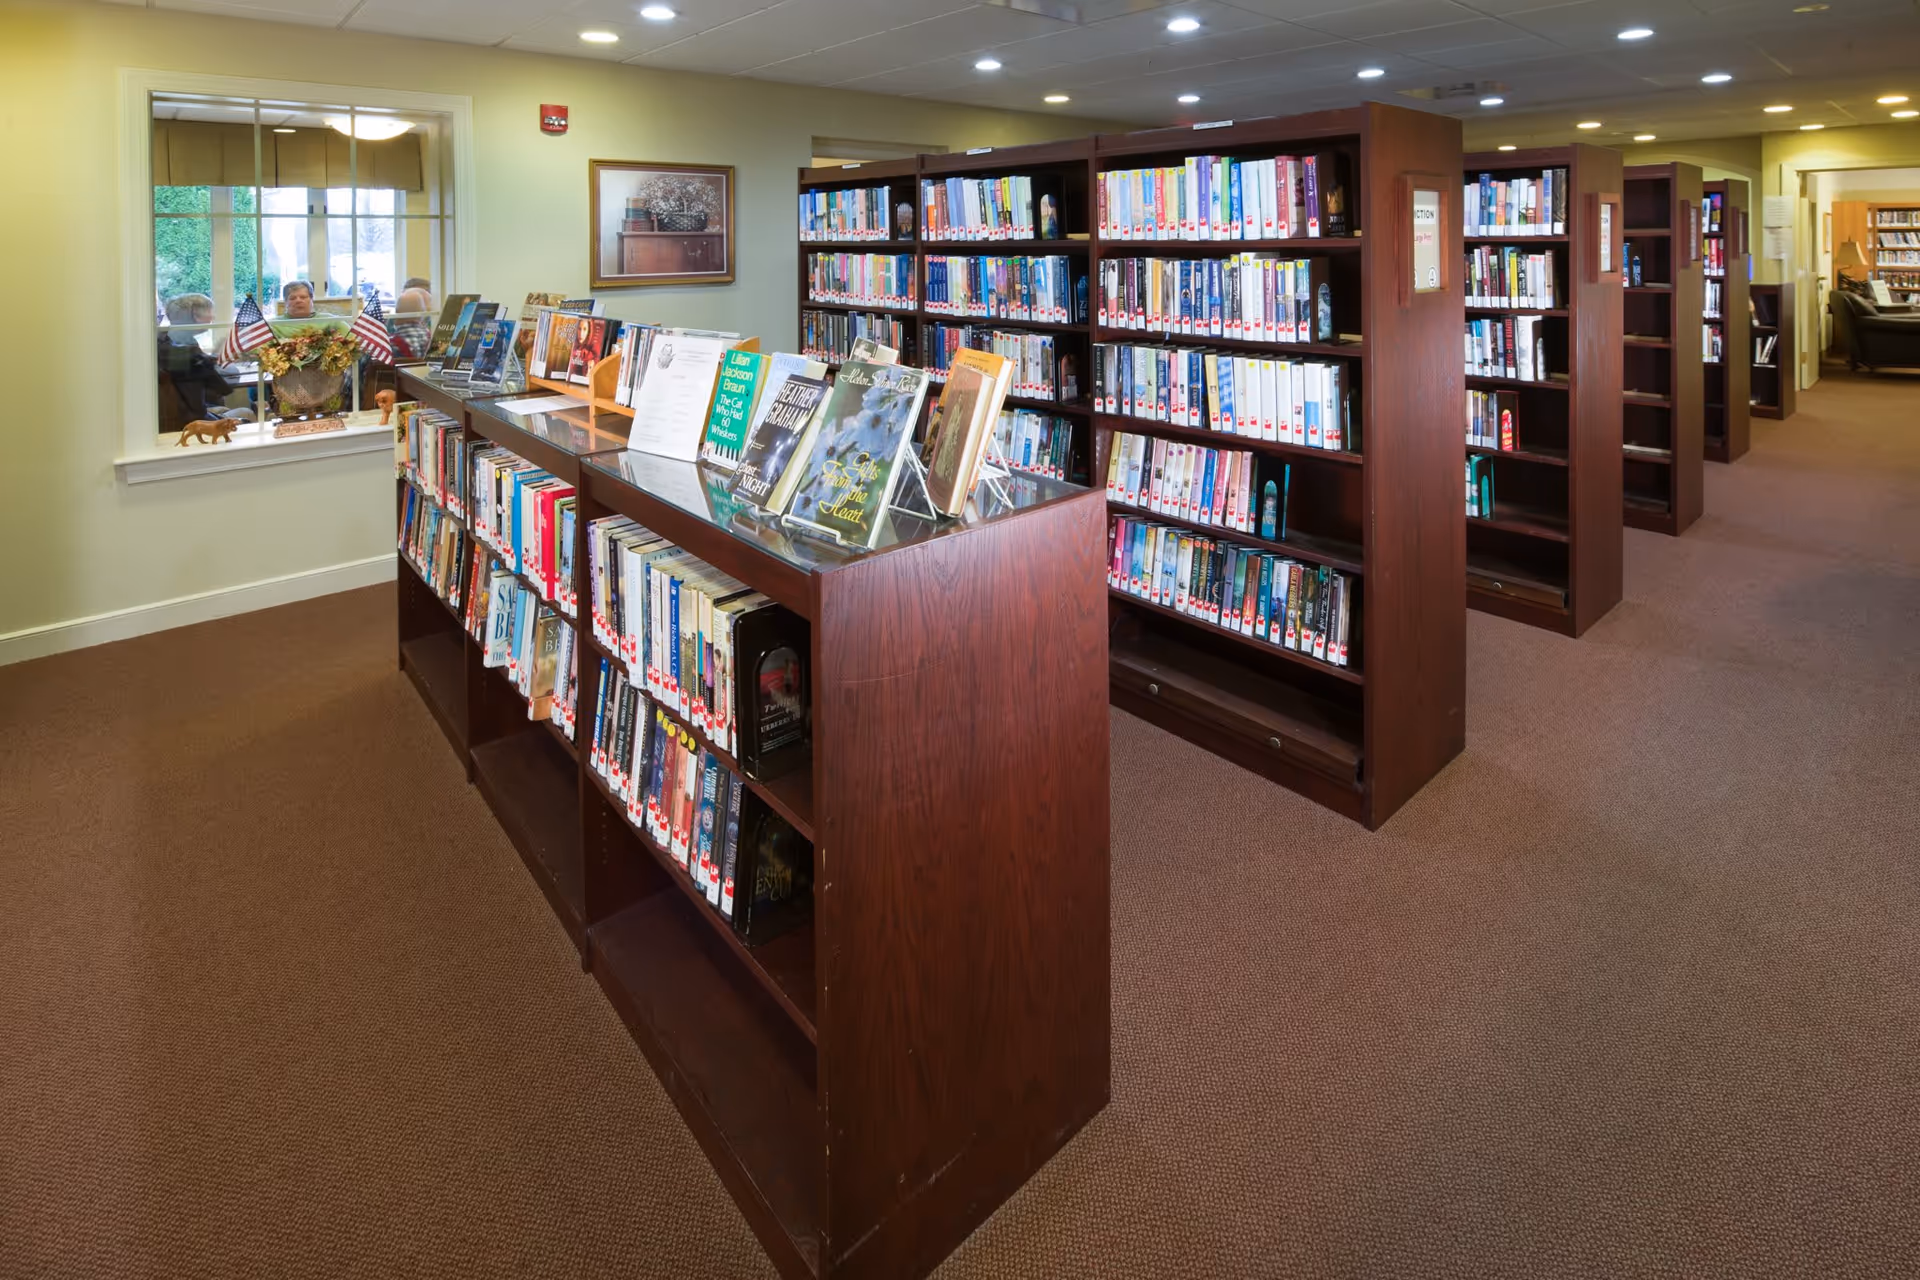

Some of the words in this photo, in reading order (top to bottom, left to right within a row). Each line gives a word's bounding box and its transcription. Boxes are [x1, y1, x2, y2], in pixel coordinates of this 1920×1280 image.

[1414, 209, 1435, 219] ICTION
[731, 353, 751, 367] Lilian
[721, 366, 754, 381] Jackson
[840, 368, 870, 386] Helen
[898, 375, 918, 393] Rice
[723, 379, 746, 394] Braun
[720, 394, 731, 406] The
[731, 396, 743, 409] Cat
[777, 382, 818, 409] HEATHER
[716, 404, 730, 417] Who
[731, 407, 744, 420] Had
[764, 402, 809, 432] GRAHAM
[721, 417, 731, 427] 60
[711, 424, 738, 441] Whiskers
[842, 452, 880, 481] Gifts
[822, 460, 852, 489] From
[739, 474, 770, 496] NIGHT
[819, 493, 864, 524] Heart
[703, 768, 711, 799] COULTER
[660, 814, 668, 824] LP
[702, 852, 710, 862] LP
[710, 866, 718, 875] LP
[726, 878, 734, 888] LP
